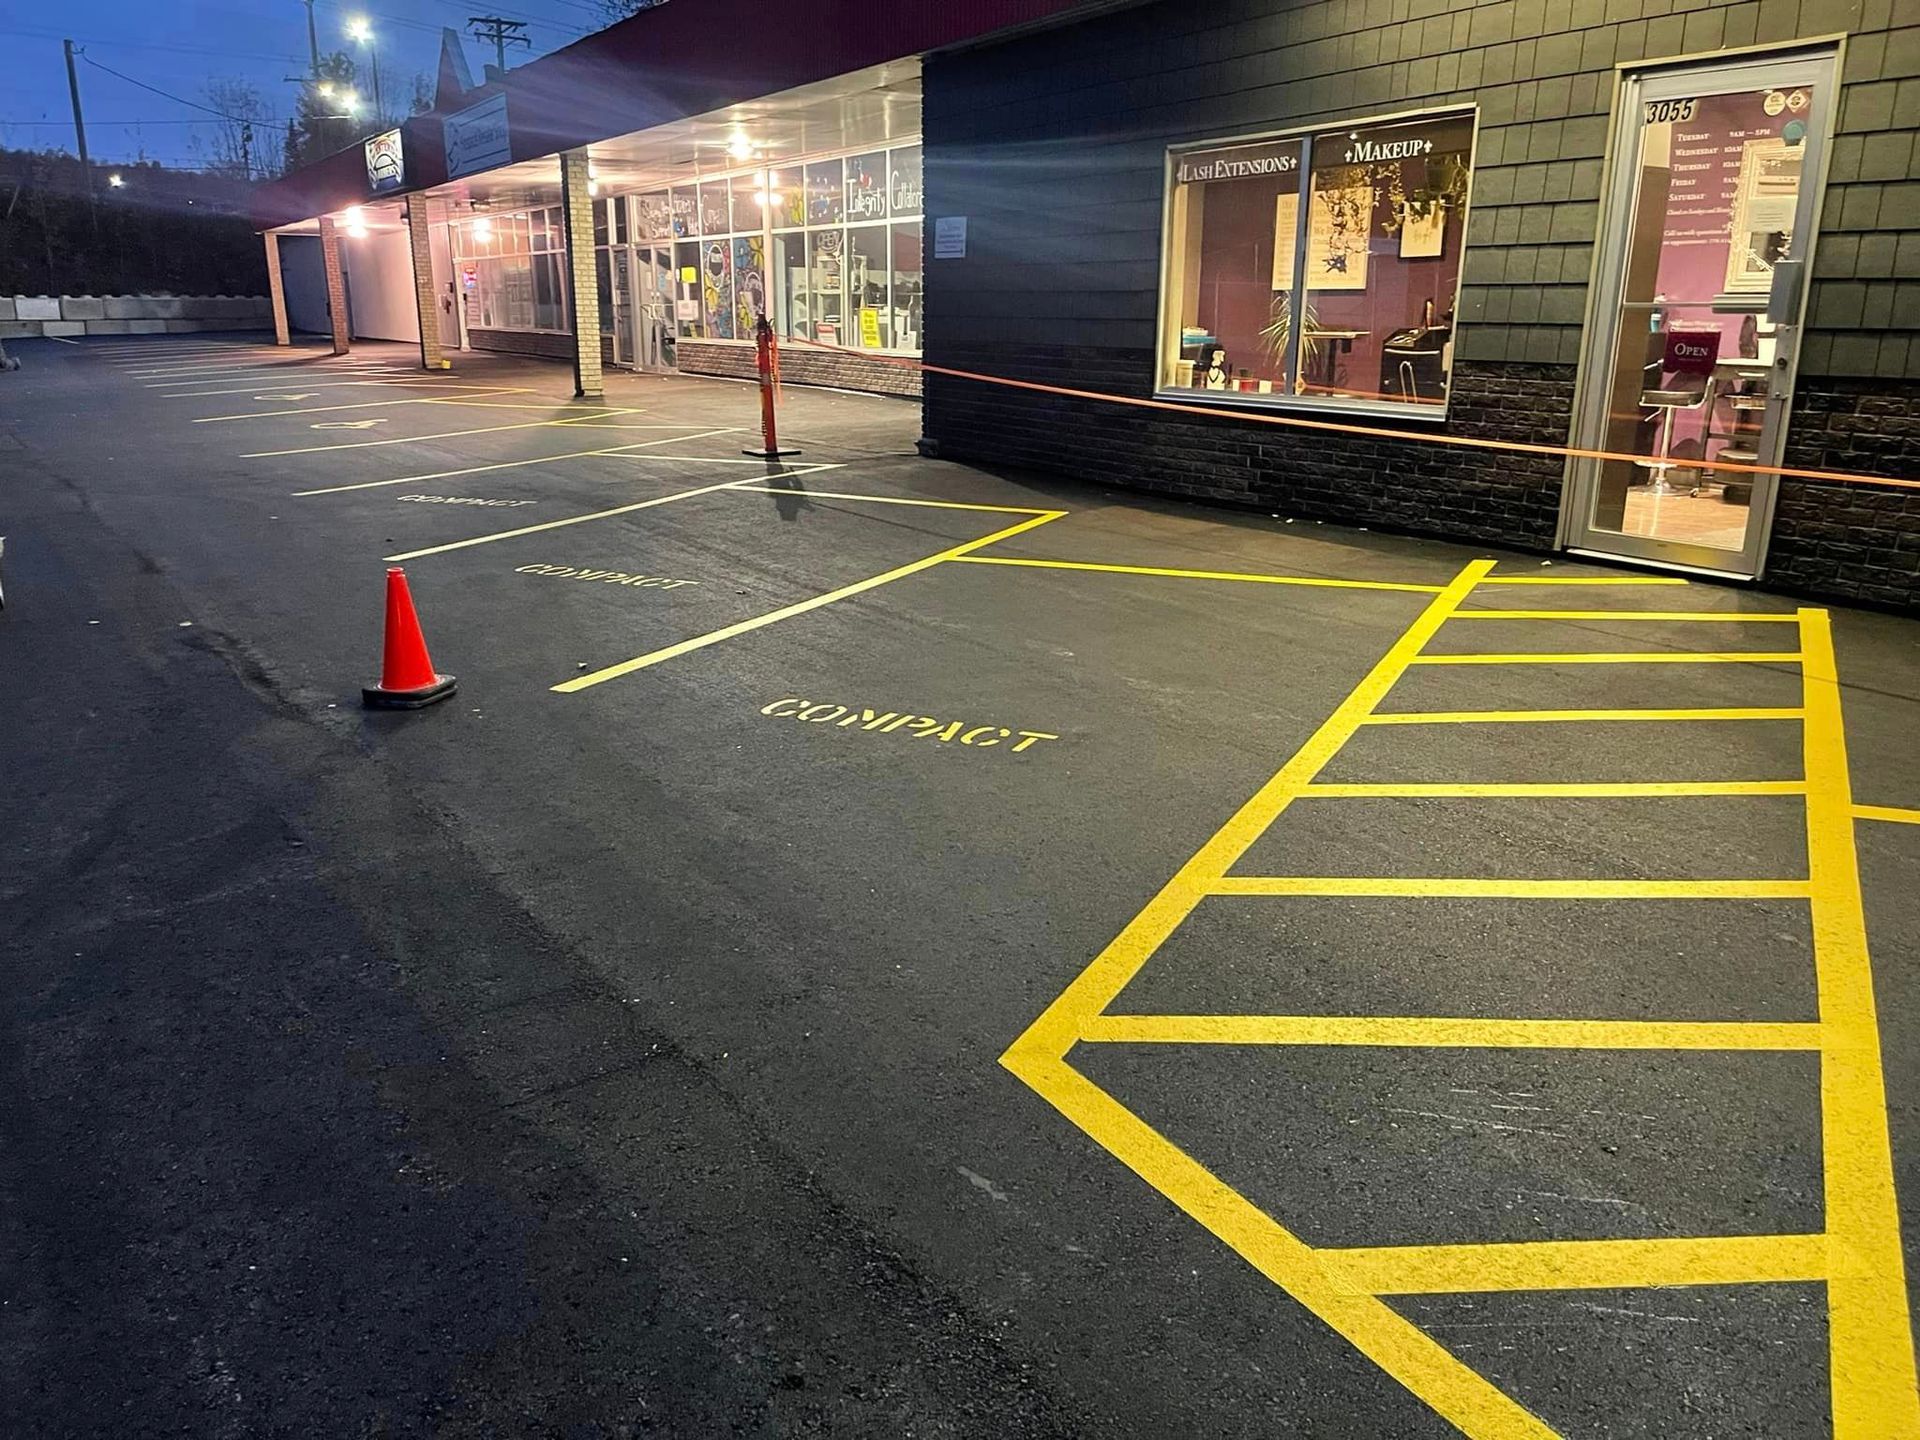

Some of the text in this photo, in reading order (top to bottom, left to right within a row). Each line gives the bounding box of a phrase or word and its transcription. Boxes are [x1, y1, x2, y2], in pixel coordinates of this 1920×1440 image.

[1647, 100, 1693, 124] 3055
[1677, 133, 1711, 142] TUESDAY
[1353, 139, 1424, 163] MAKEUP
[1675, 148, 1719, 156] WEDNESDAY
[1183, 156, 1290, 181] LASH EXTENSIONS
[1673, 163, 1712, 172] THURSDAY
[1671, 179, 1697, 187] FRIDAY
[846, 178, 886, 217] Integrity
[1668, 193, 1706, 201] SATURDAY
[1674, 343, 1709, 356] OPEN
[397, 494, 539, 507] COMPACT
[514, 563, 701, 590] COMPACT
[760, 698, 1060, 752] COMPACT
